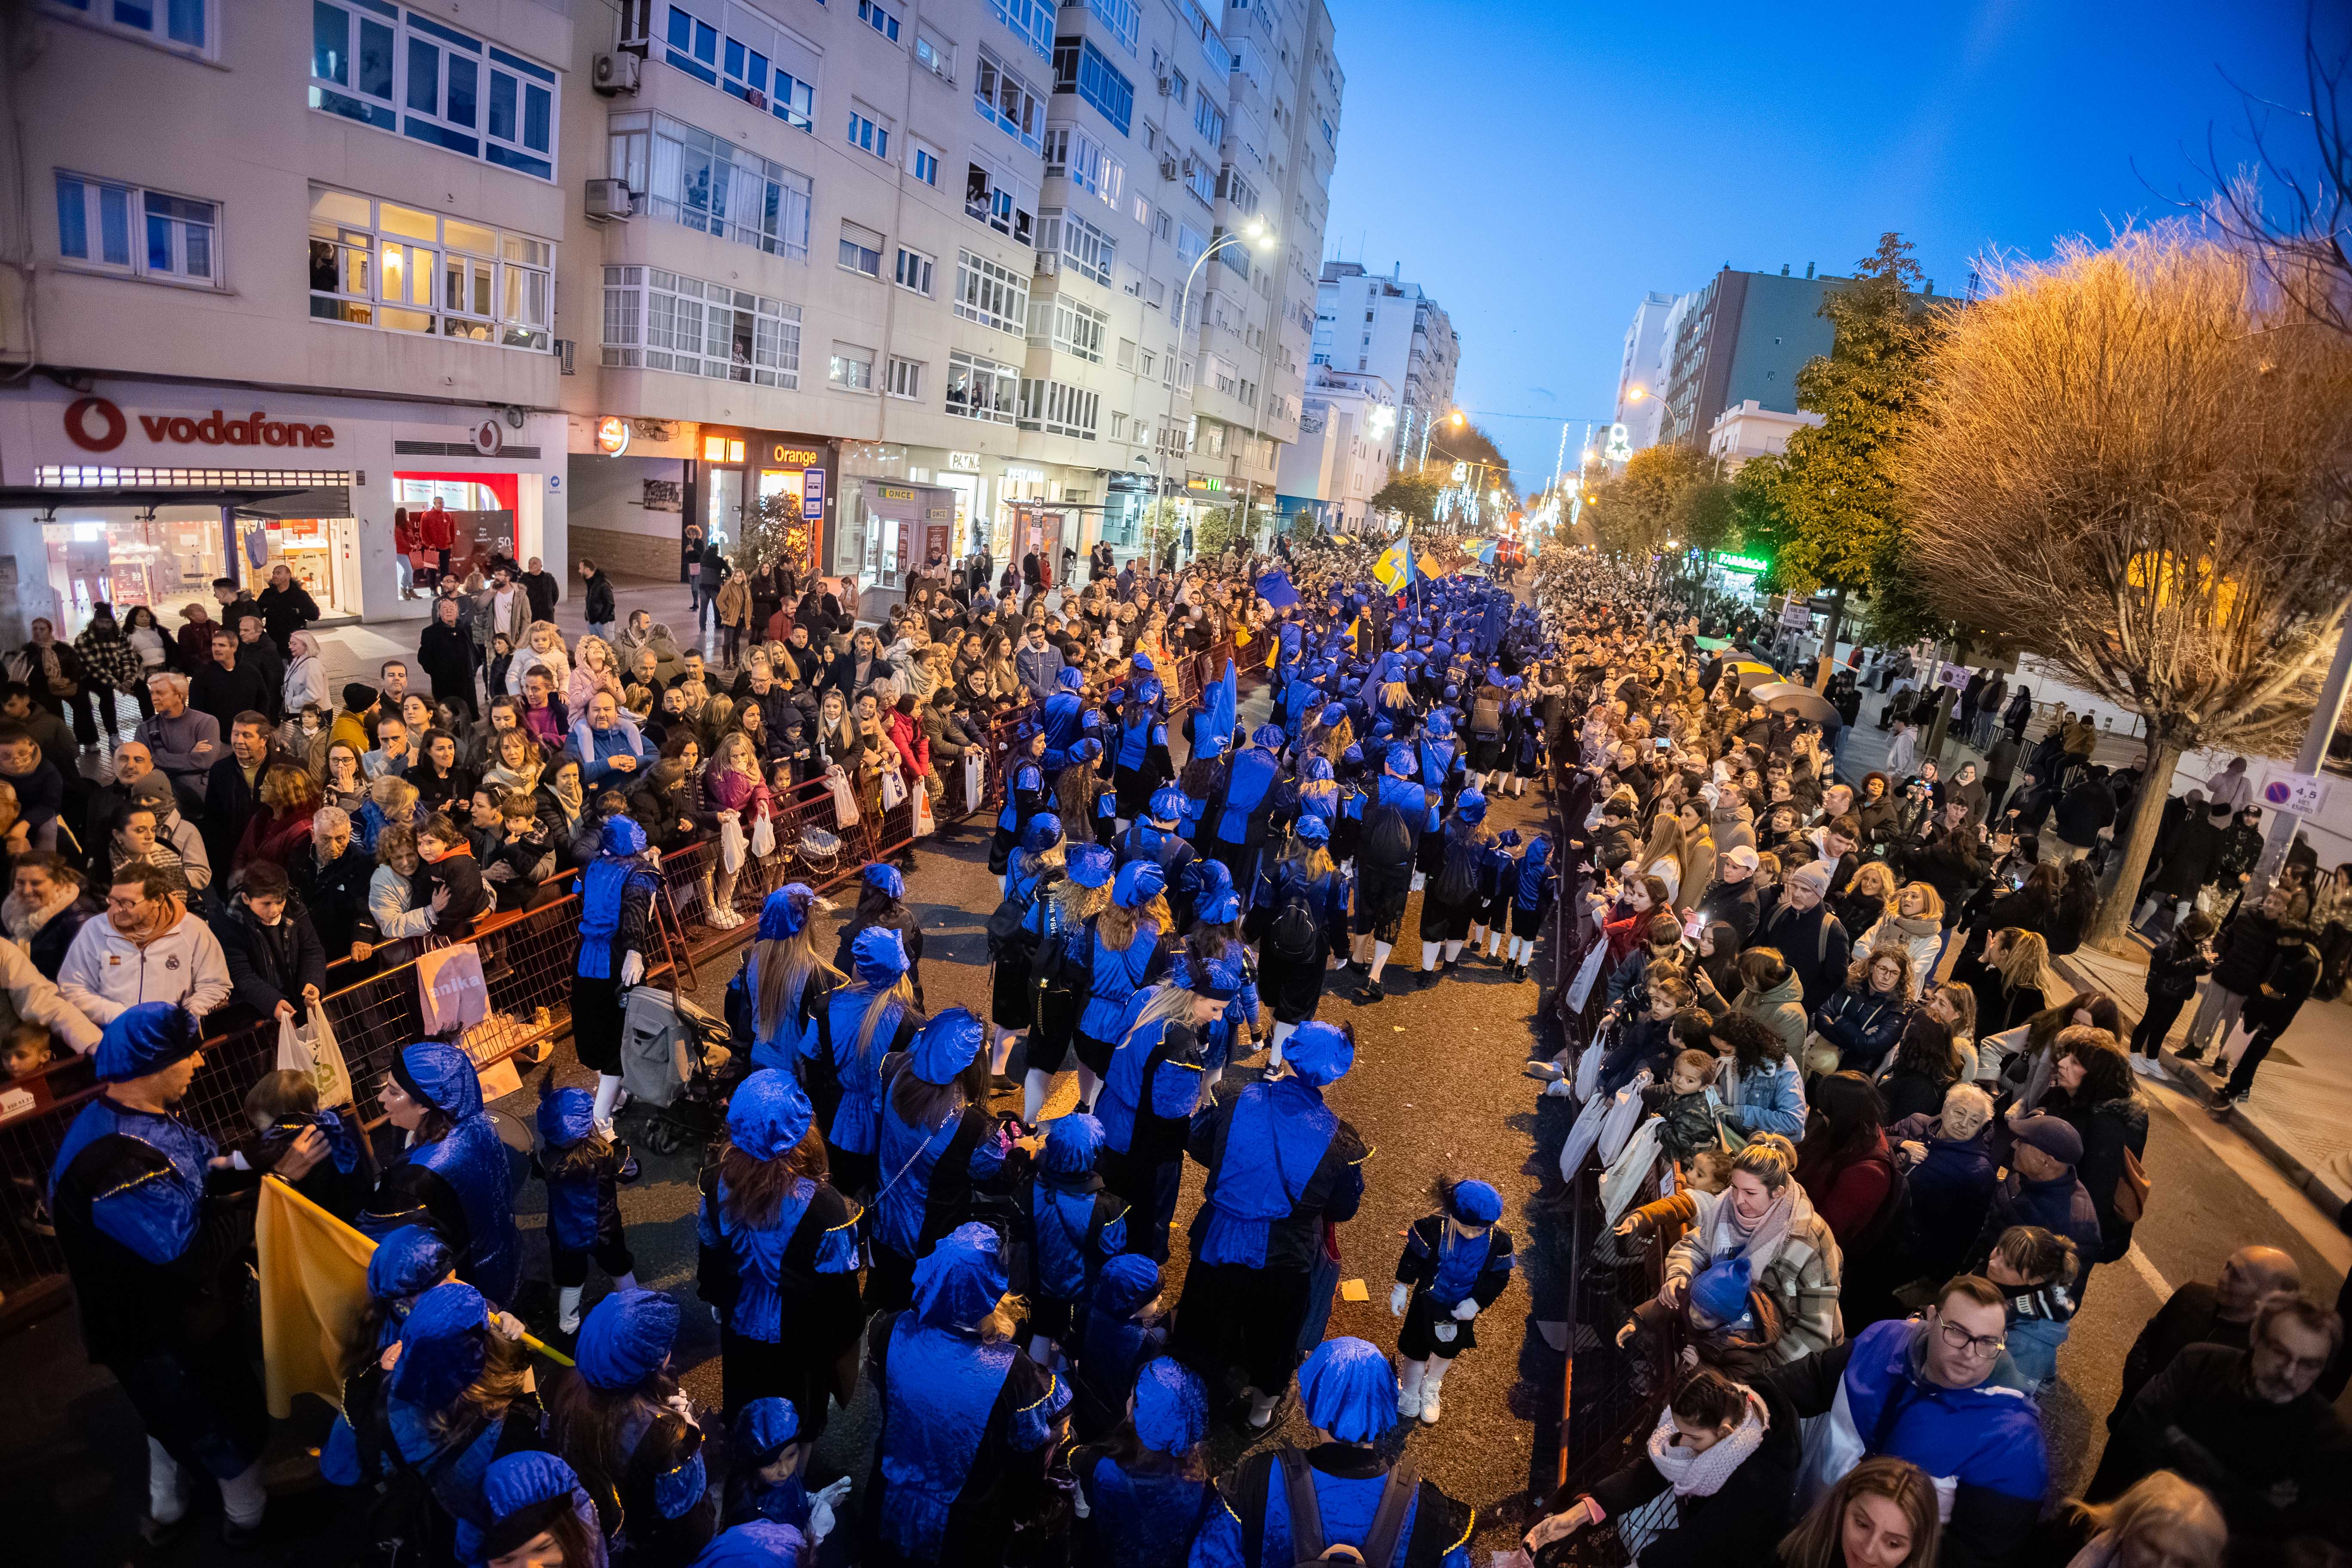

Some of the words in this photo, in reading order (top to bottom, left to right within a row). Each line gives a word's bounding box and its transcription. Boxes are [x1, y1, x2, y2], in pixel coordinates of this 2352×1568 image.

[139, 410, 335, 448] vodafone
[774, 445, 817, 467] Orange
[889, 490, 912, 499] ONCE
[1207, 478, 1221, 491] EVA
[429, 975, 481, 999] anika
